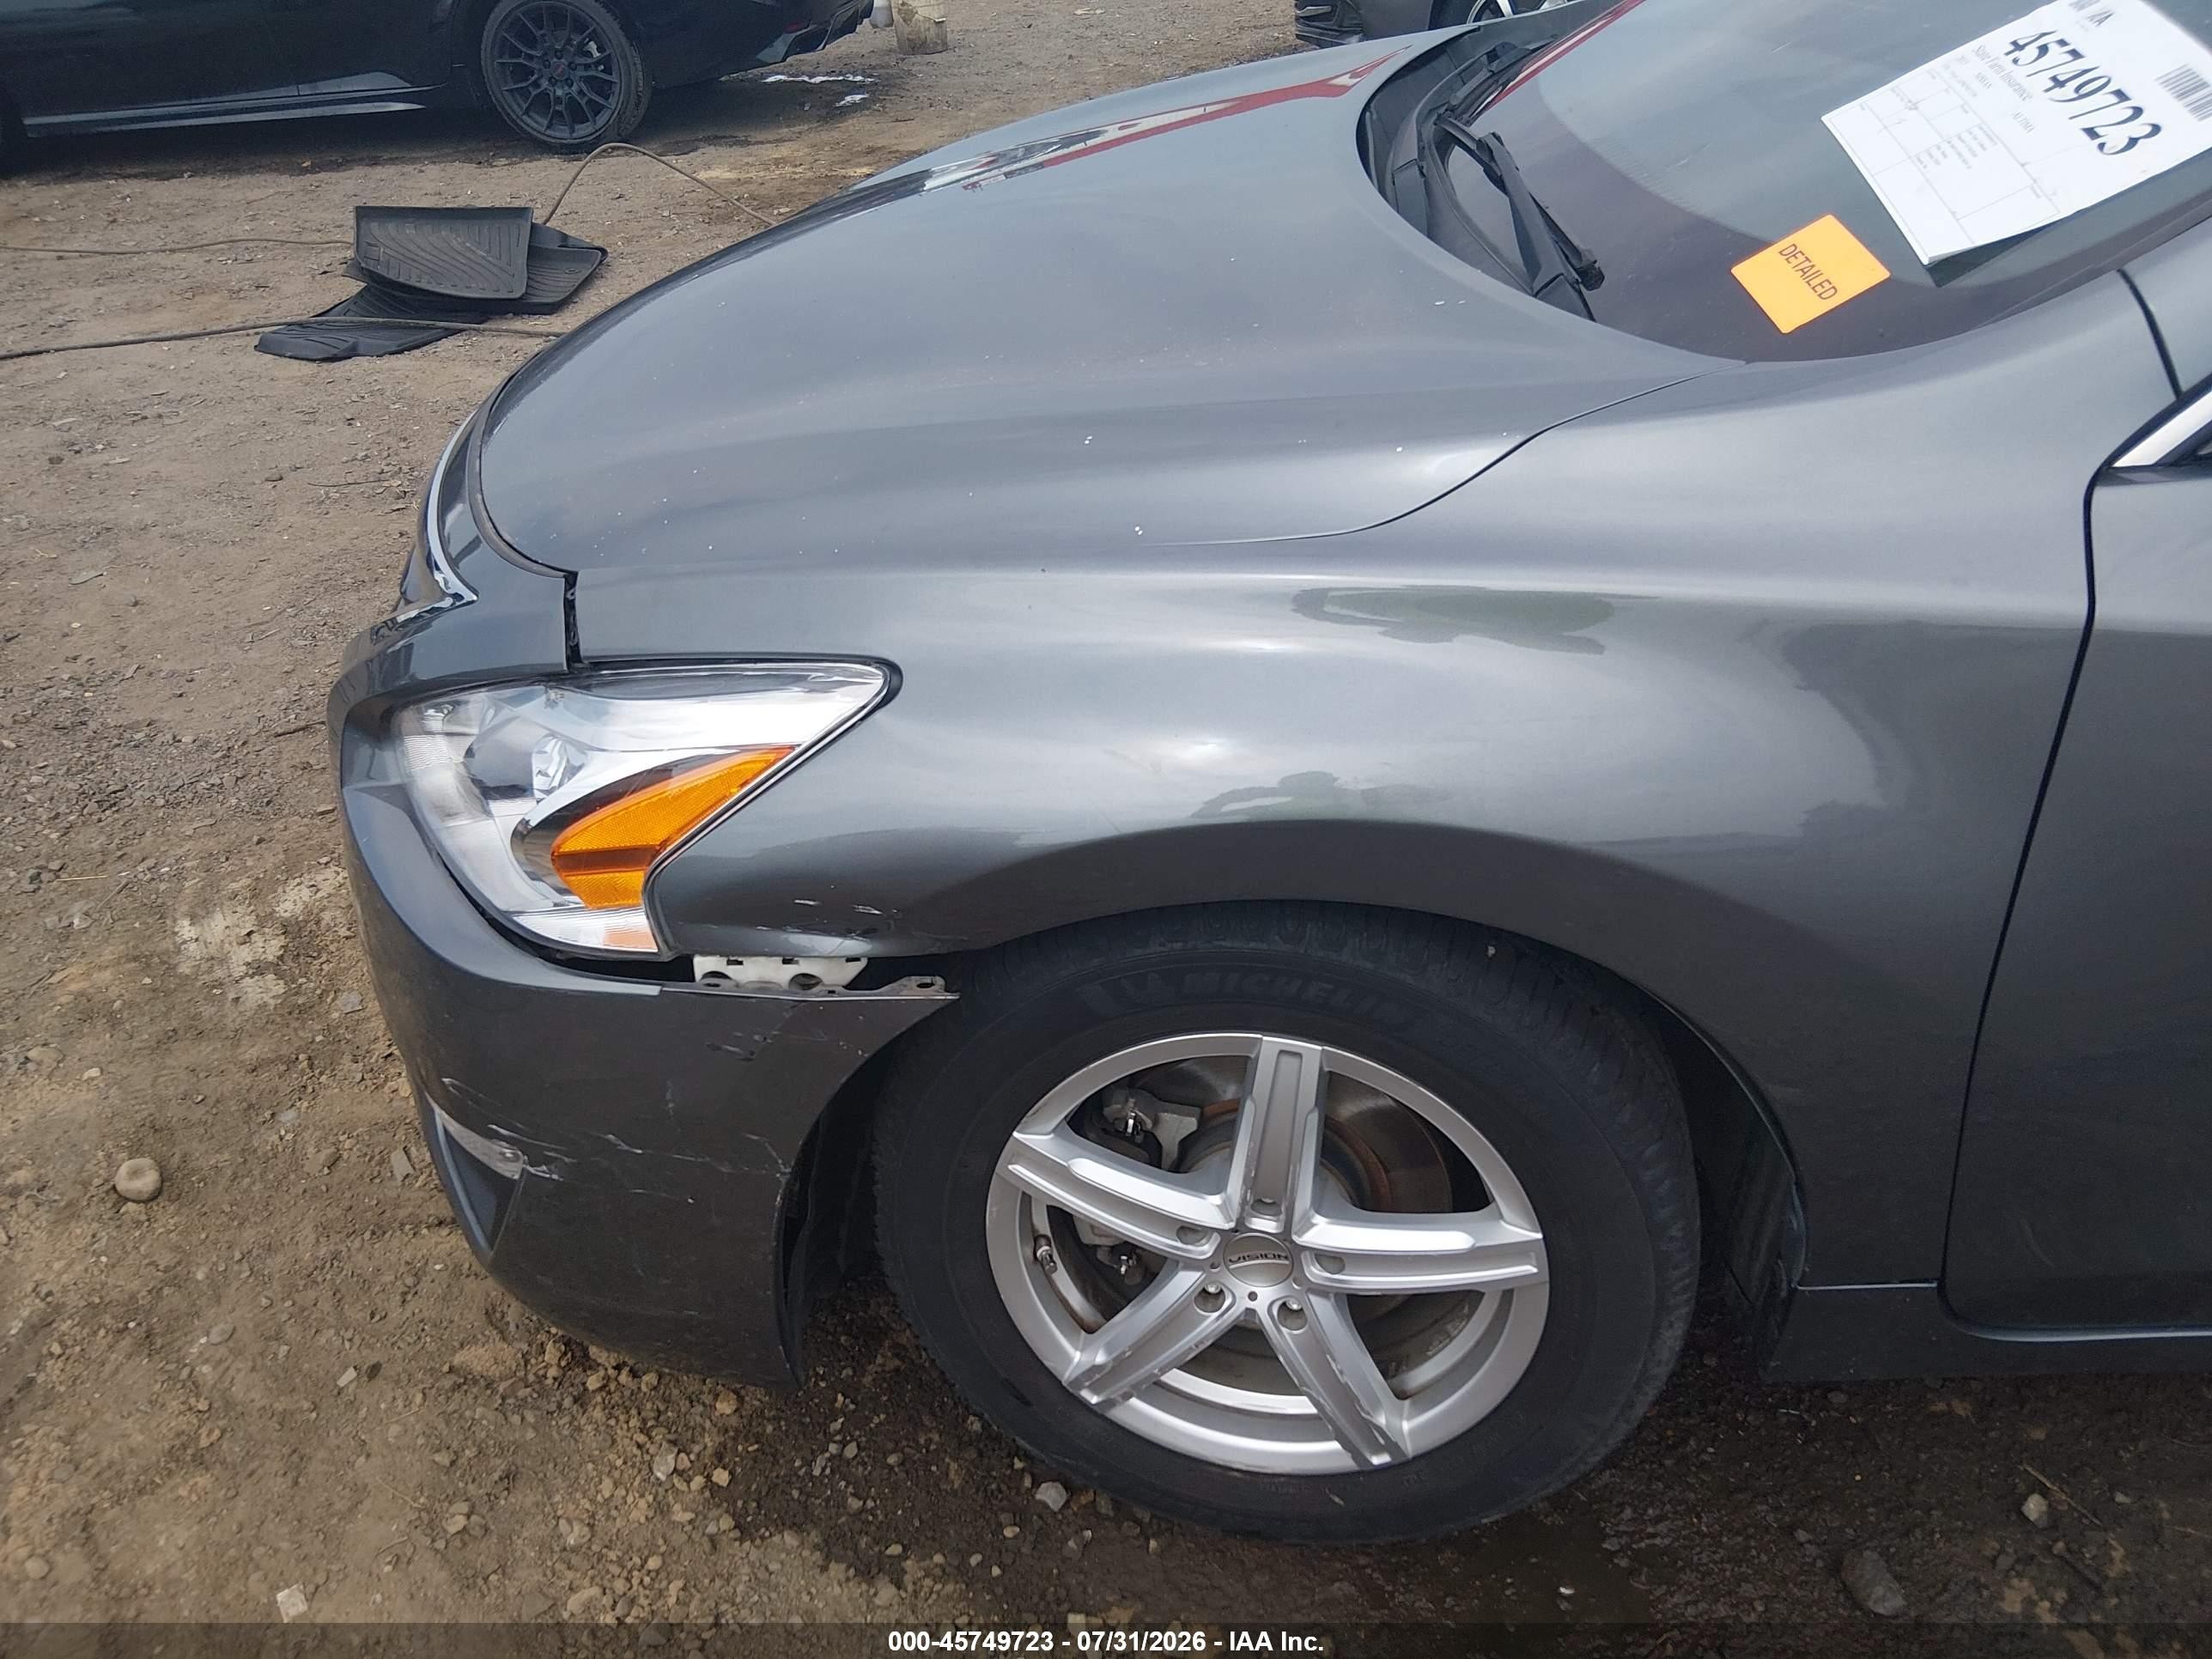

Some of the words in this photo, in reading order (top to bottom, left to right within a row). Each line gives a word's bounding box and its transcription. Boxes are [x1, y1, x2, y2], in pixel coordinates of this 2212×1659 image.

[1985, 57, 2006, 76] Farm
[2000, 70, 2033, 101] Insurance
[2004, 29, 2162, 155] 45749723
[1778, 243, 1838, 301] DETAILED
[1182, 970, 1417, 1025] MICHELIN
[1227, 1252, 1290, 1263] VISION
